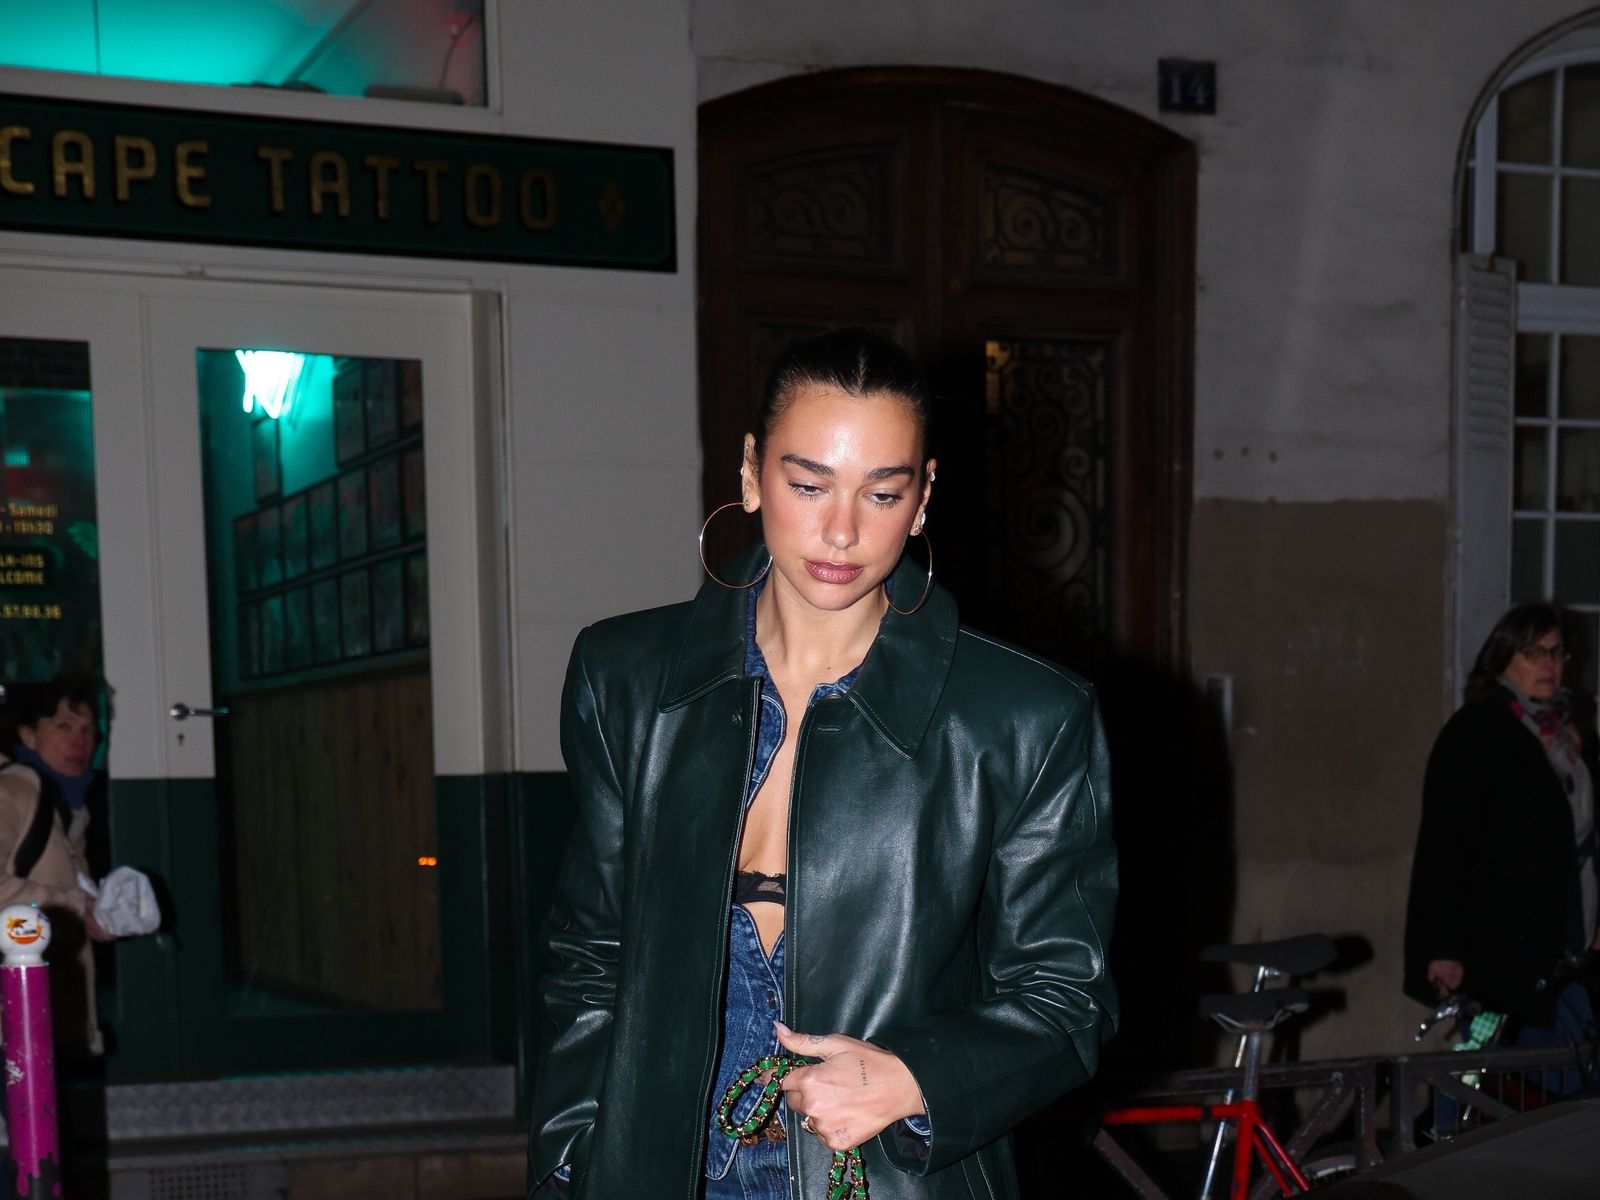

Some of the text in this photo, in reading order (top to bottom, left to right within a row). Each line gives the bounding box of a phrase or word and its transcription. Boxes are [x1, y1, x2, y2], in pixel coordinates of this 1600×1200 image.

[1168, 73, 1209, 106] 14
[0, 123, 559, 232] CAPE TATTOO
